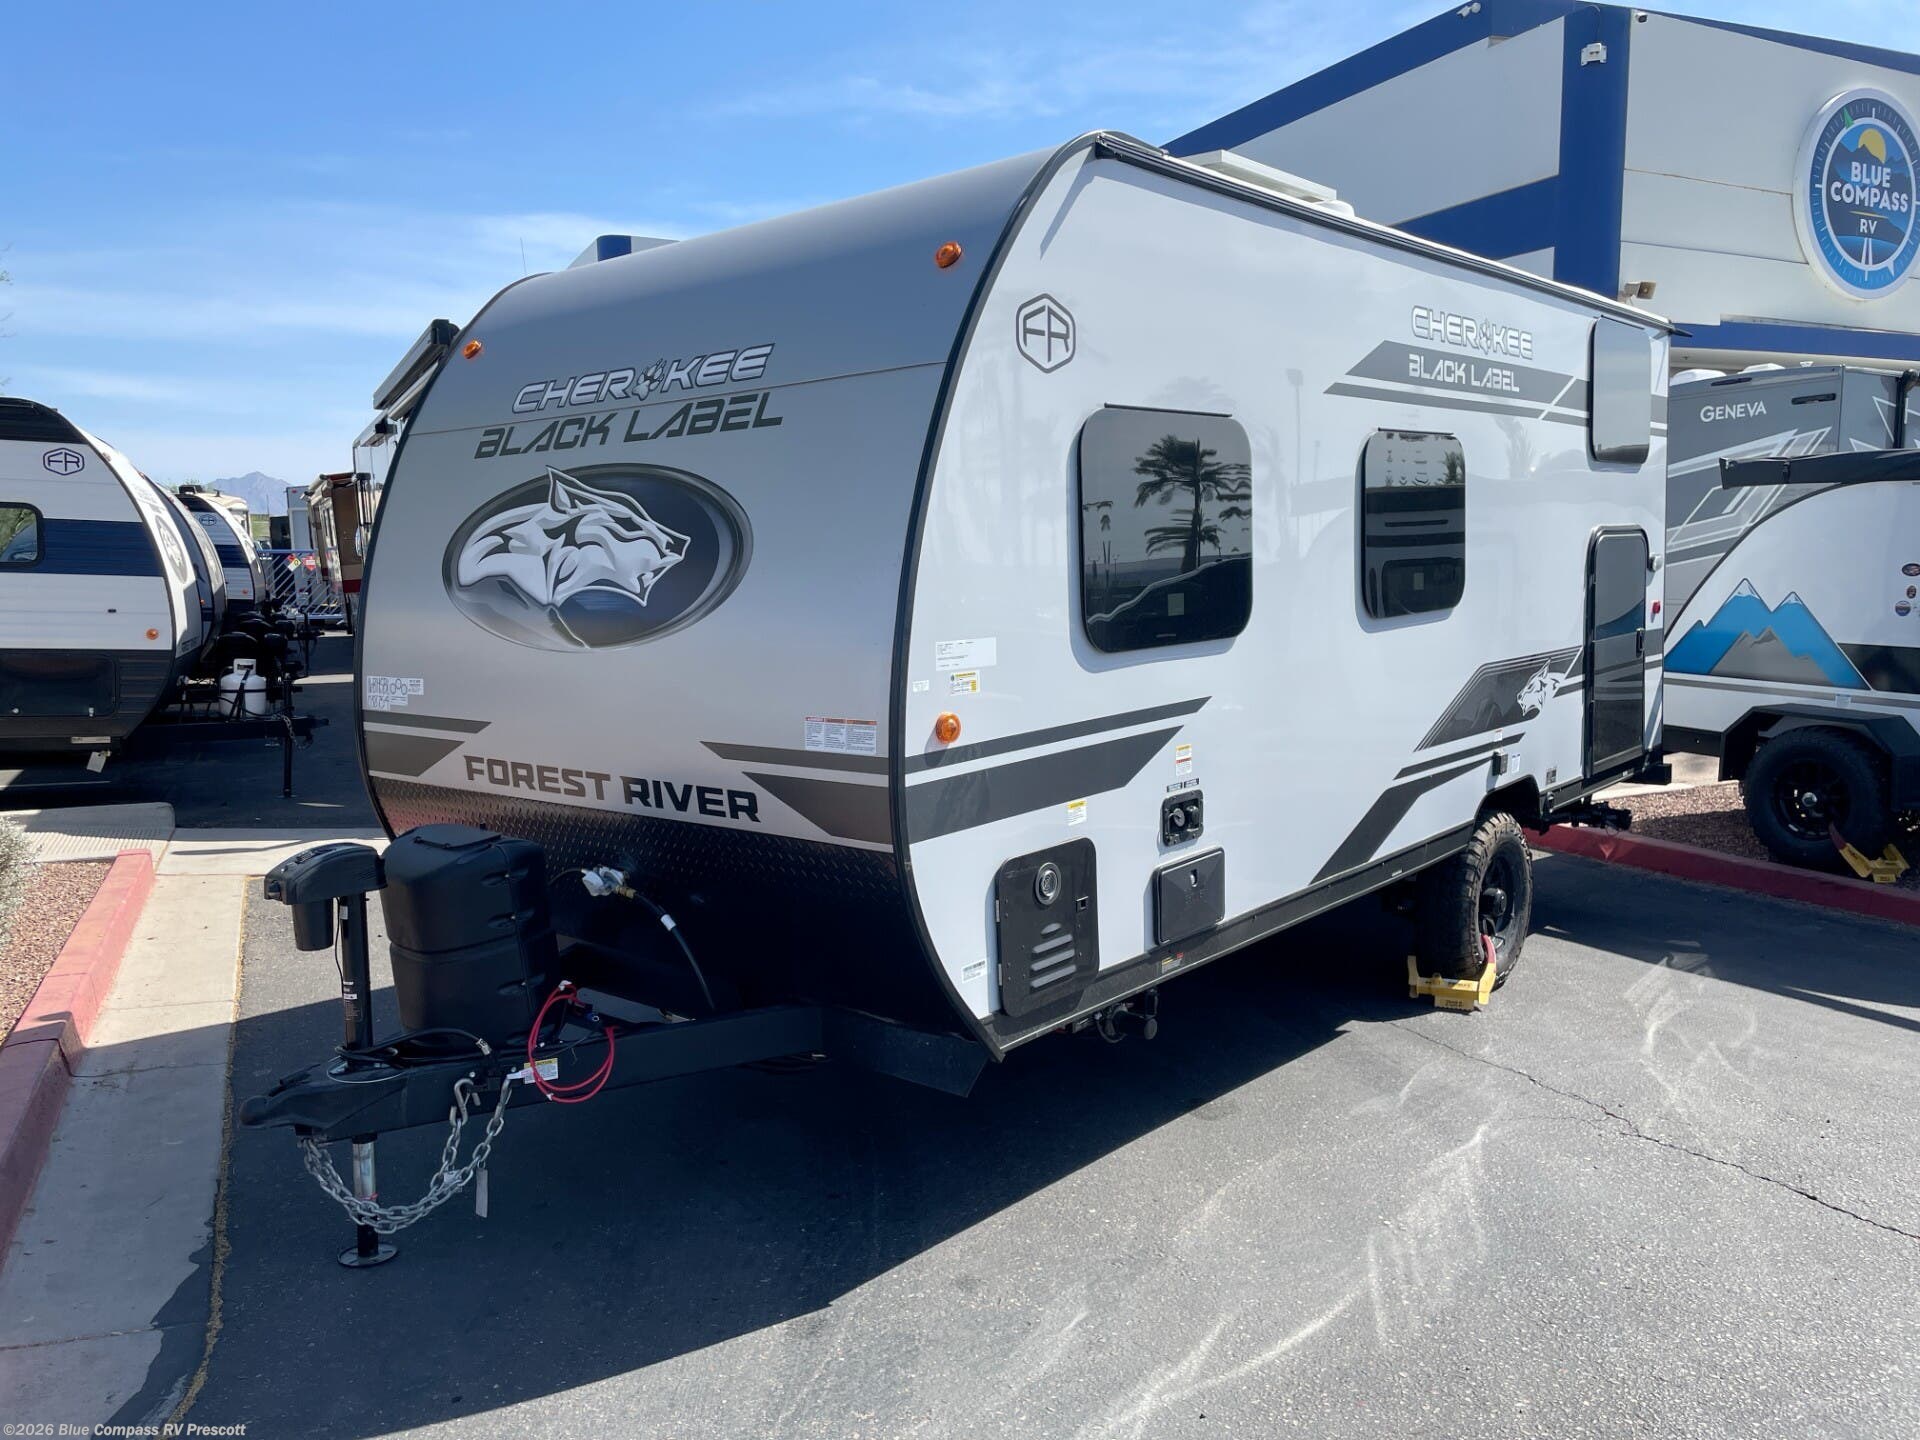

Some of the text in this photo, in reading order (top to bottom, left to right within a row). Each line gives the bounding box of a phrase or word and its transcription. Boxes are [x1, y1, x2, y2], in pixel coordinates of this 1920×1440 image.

[1851, 161, 1892, 189] BLUE
[1830, 181, 1909, 213] COMPASS
[1859, 218, 1878, 235] RV
[1408, 352, 1521, 393] BLACK LABEL
[473, 391, 784, 460] BLACK LABEL
[1699, 399, 1768, 423] GENEVA
[47, 451, 81, 473] FR
[463, 754, 761, 823] FOREST RIVER
